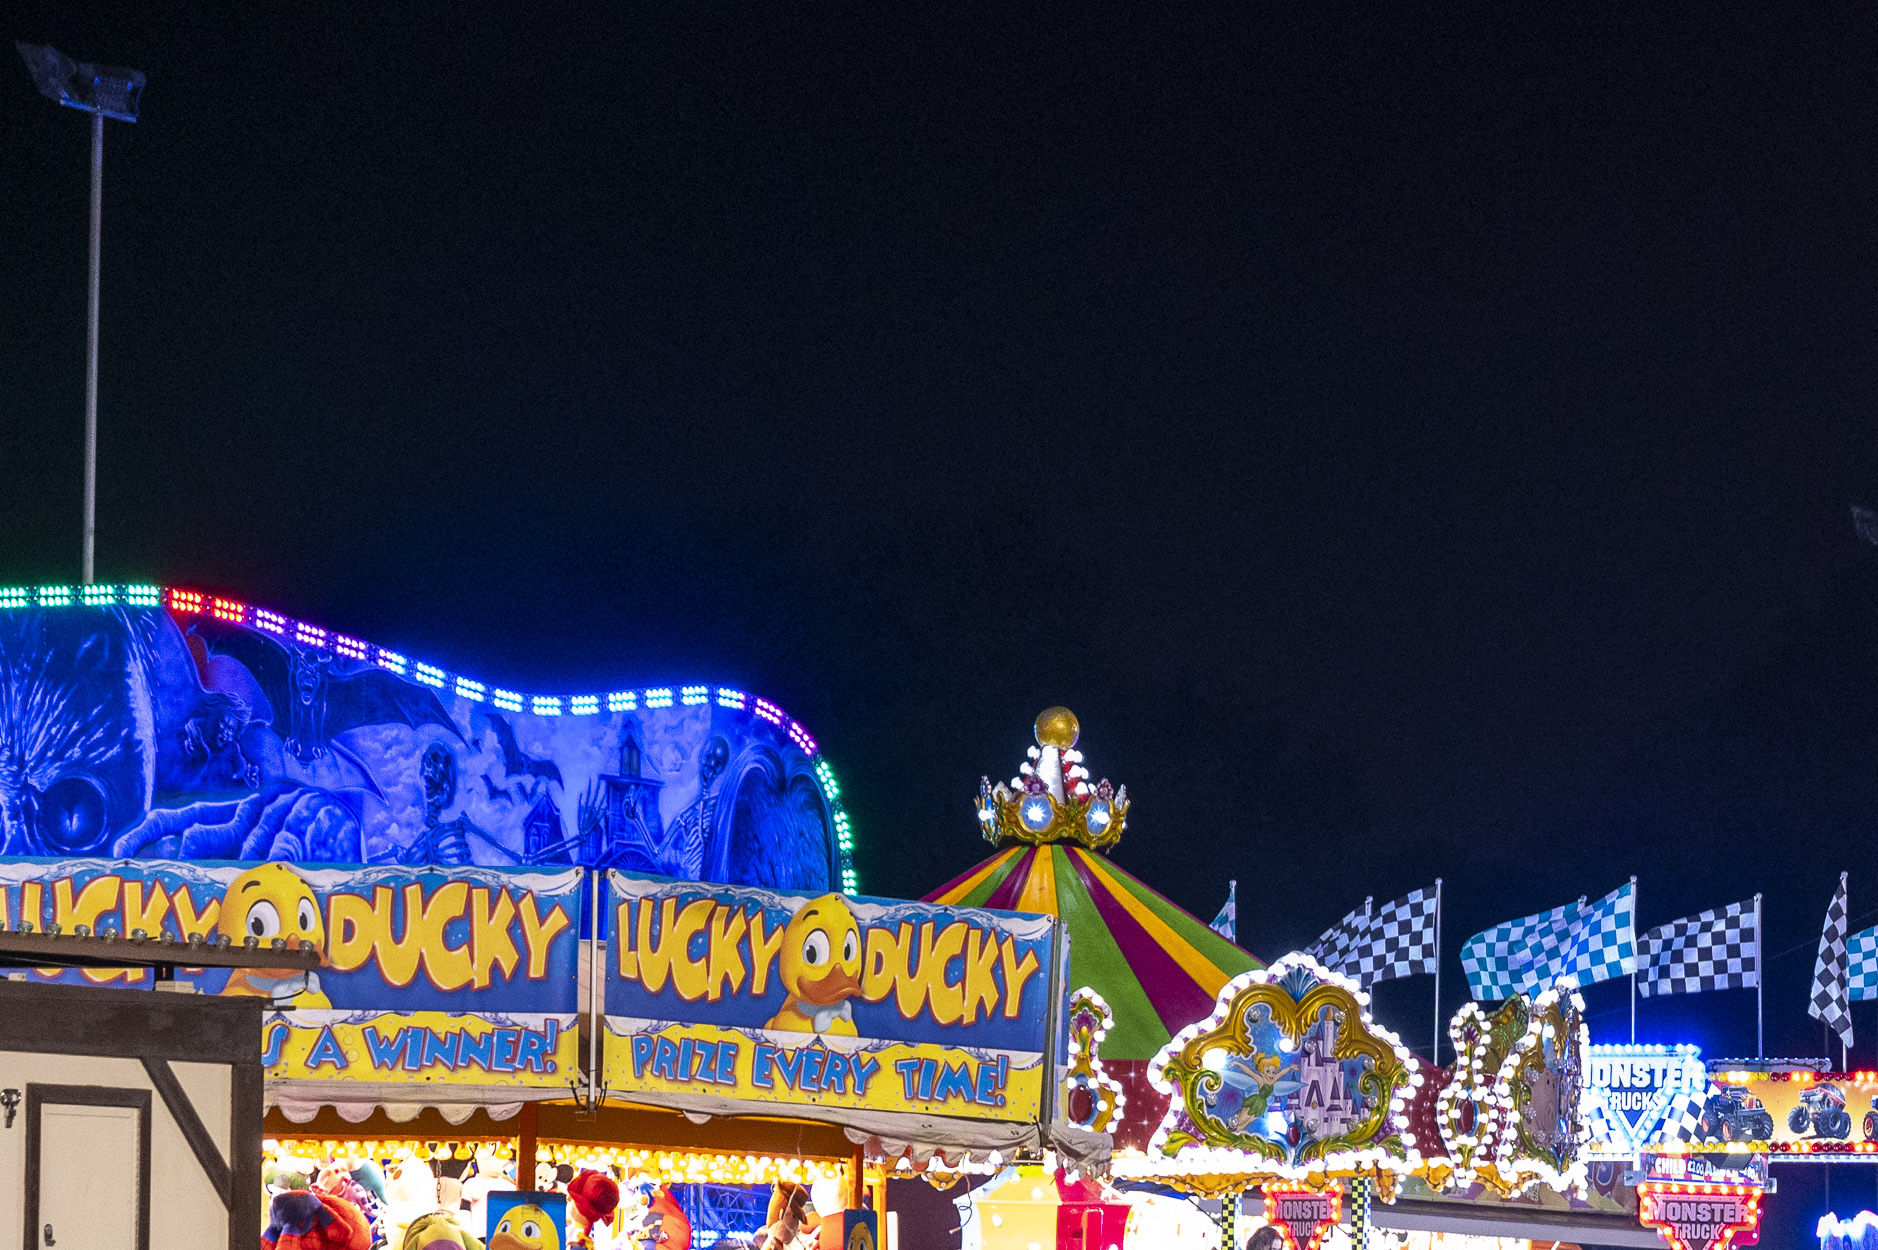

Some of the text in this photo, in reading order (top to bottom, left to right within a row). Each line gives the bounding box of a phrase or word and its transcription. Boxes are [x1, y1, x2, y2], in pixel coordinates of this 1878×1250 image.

[0, 874, 571, 993] UCKY DUCKY
[615, 896, 1040, 1026] LUCKY DUCKY
[304, 1024, 348, 1069] A
[362, 1018, 560, 1074] WINNER!
[631, 1034, 1010, 1107] PRIZE EVERY TIME!
[1655, 1156, 1687, 1175] CHILD
[1649, 1201, 1750, 1223] MONSTER
